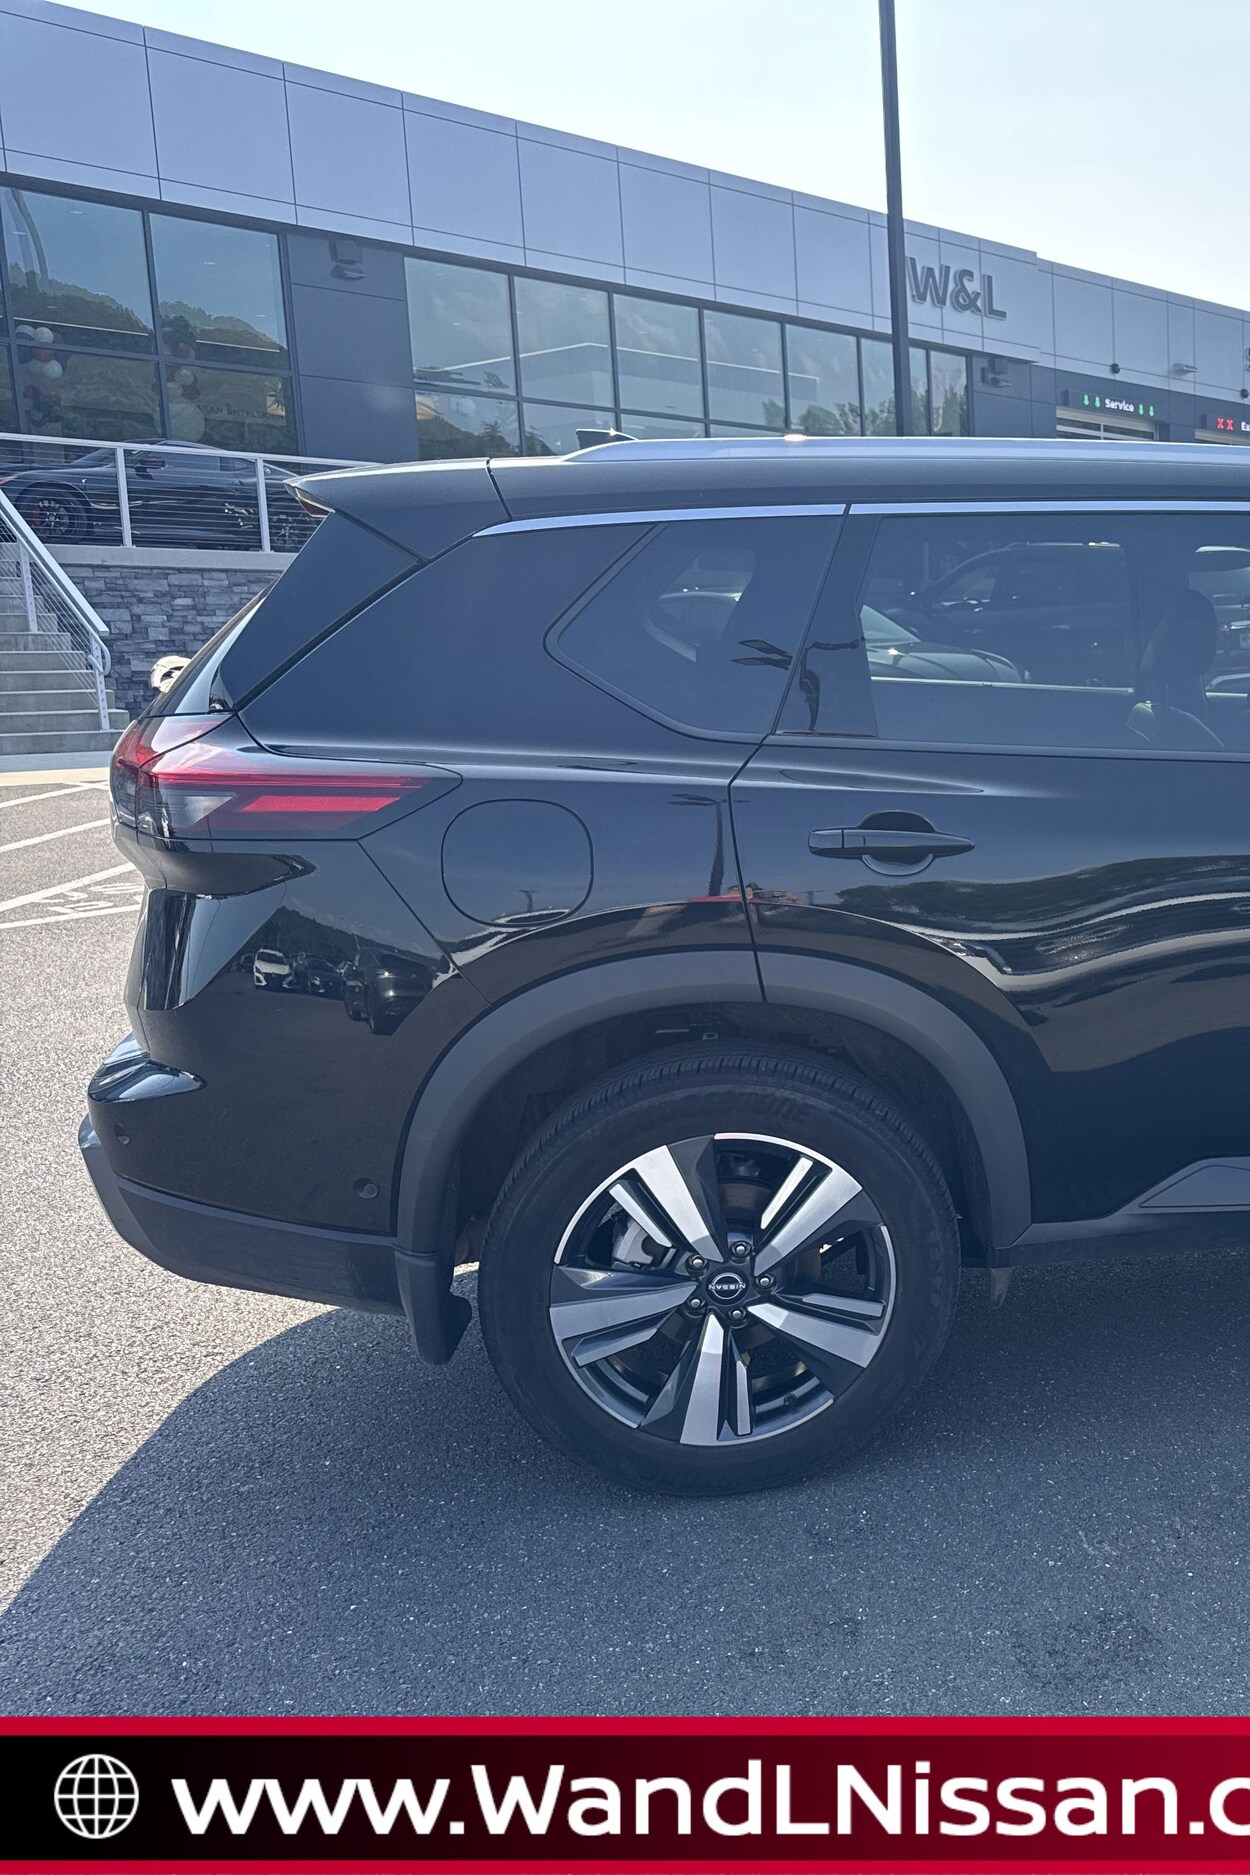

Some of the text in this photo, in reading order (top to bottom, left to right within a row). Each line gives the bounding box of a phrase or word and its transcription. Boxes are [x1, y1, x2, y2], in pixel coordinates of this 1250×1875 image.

[906, 256, 1007, 319] W&L
[1105, 398, 1135, 412] Service
[708, 1283, 746, 1291] NISSAN
